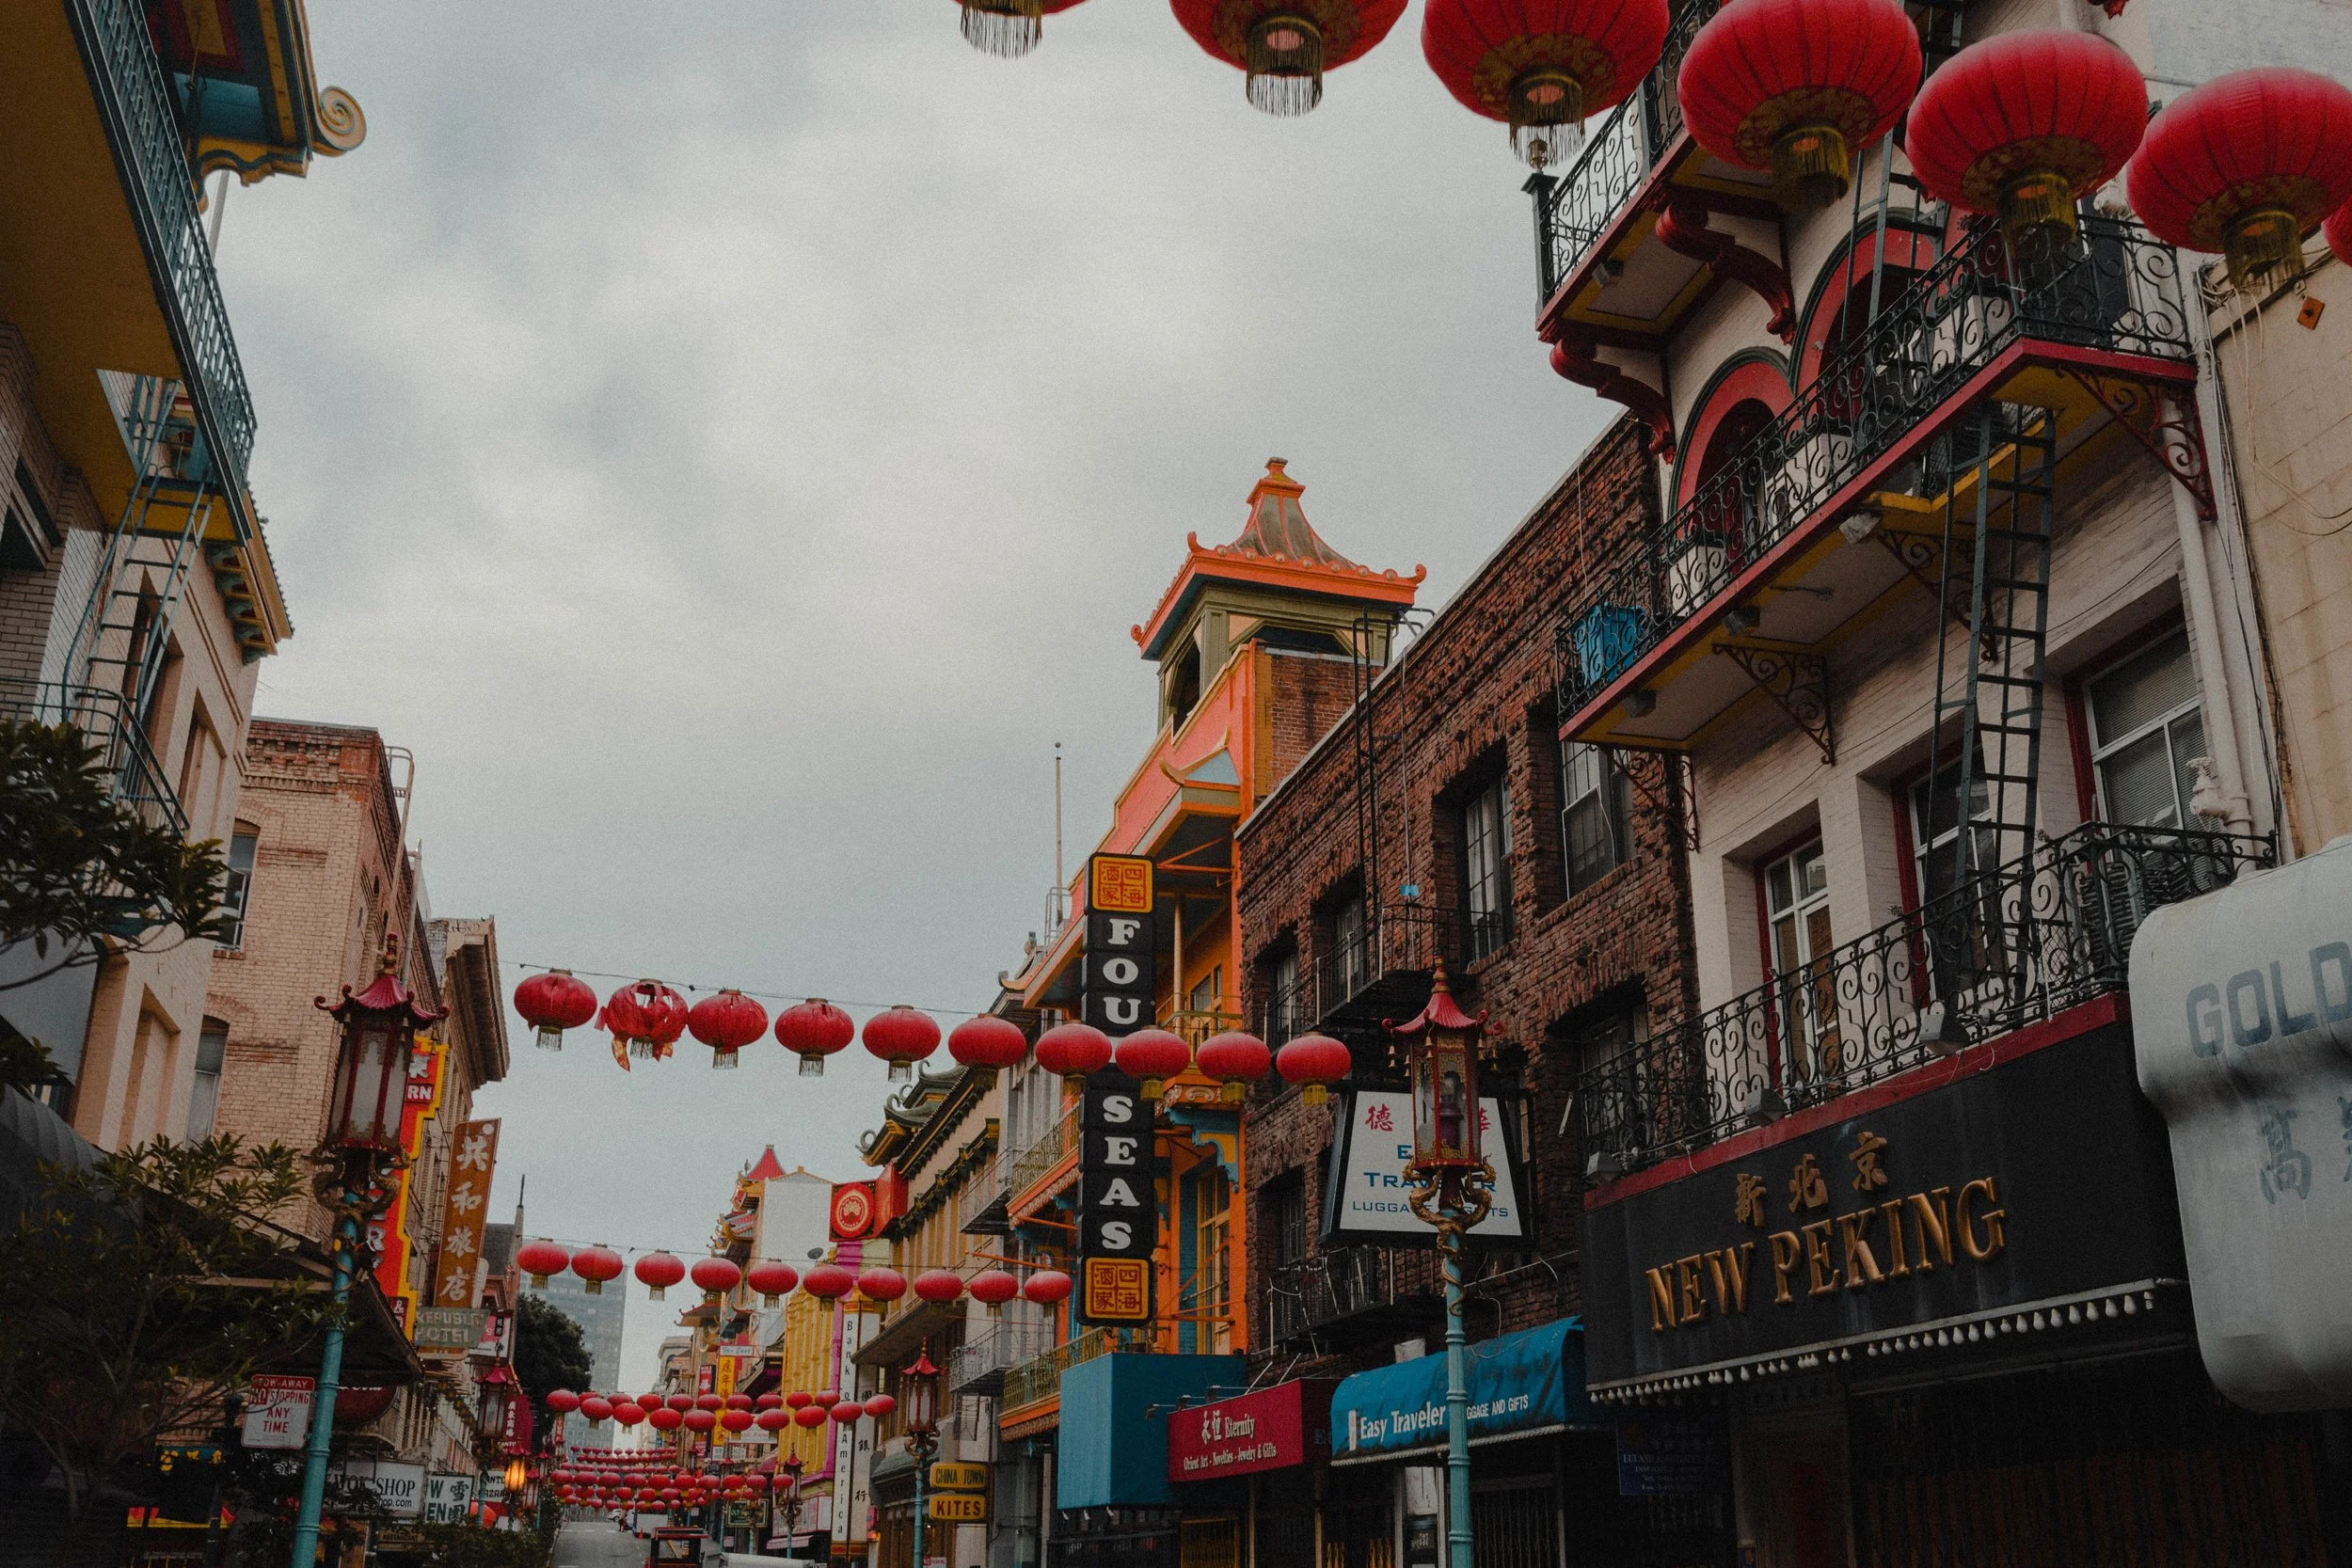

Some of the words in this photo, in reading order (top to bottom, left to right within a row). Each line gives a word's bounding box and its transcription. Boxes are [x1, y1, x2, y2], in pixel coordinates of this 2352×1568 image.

[1103, 918, 1141, 1064] FOU
[1099, 1095, 1140, 1250] SEAS
[1735, 1131, 1889, 1228] 新北京
[437, 1134, 489, 1302] 共和旅店
[1645, 1242, 1756, 1334] NEW
[1768, 1177, 2008, 1306] PEKING
[414, 1326, 469, 1343] HOTEL
[257, 1377, 309, 1389] TOW-AWAY
[268, 1389, 310, 1404] STOPPING
[266, 1407, 290, 1418] ANY
[1466, 1403, 1489, 1420] GGAGE
[1491, 1399, 1506, 1416] AND
[1508, 1393, 1529, 1411] GIFTS
[262, 1420, 289, 1433] TIME
[1225, 1413, 1255, 1440] Eternity
[1359, 1416, 1389, 1444] Easy
[1391, 1401, 1447, 1434] Traveler
[376, 1478, 416, 1497] SHOP
[837, 1433, 848, 1534] America
[935, 1467, 958, 1484] CHINA
[963, 1468, 986, 1485] TOWN
[936, 1500, 981, 1516] KITES
